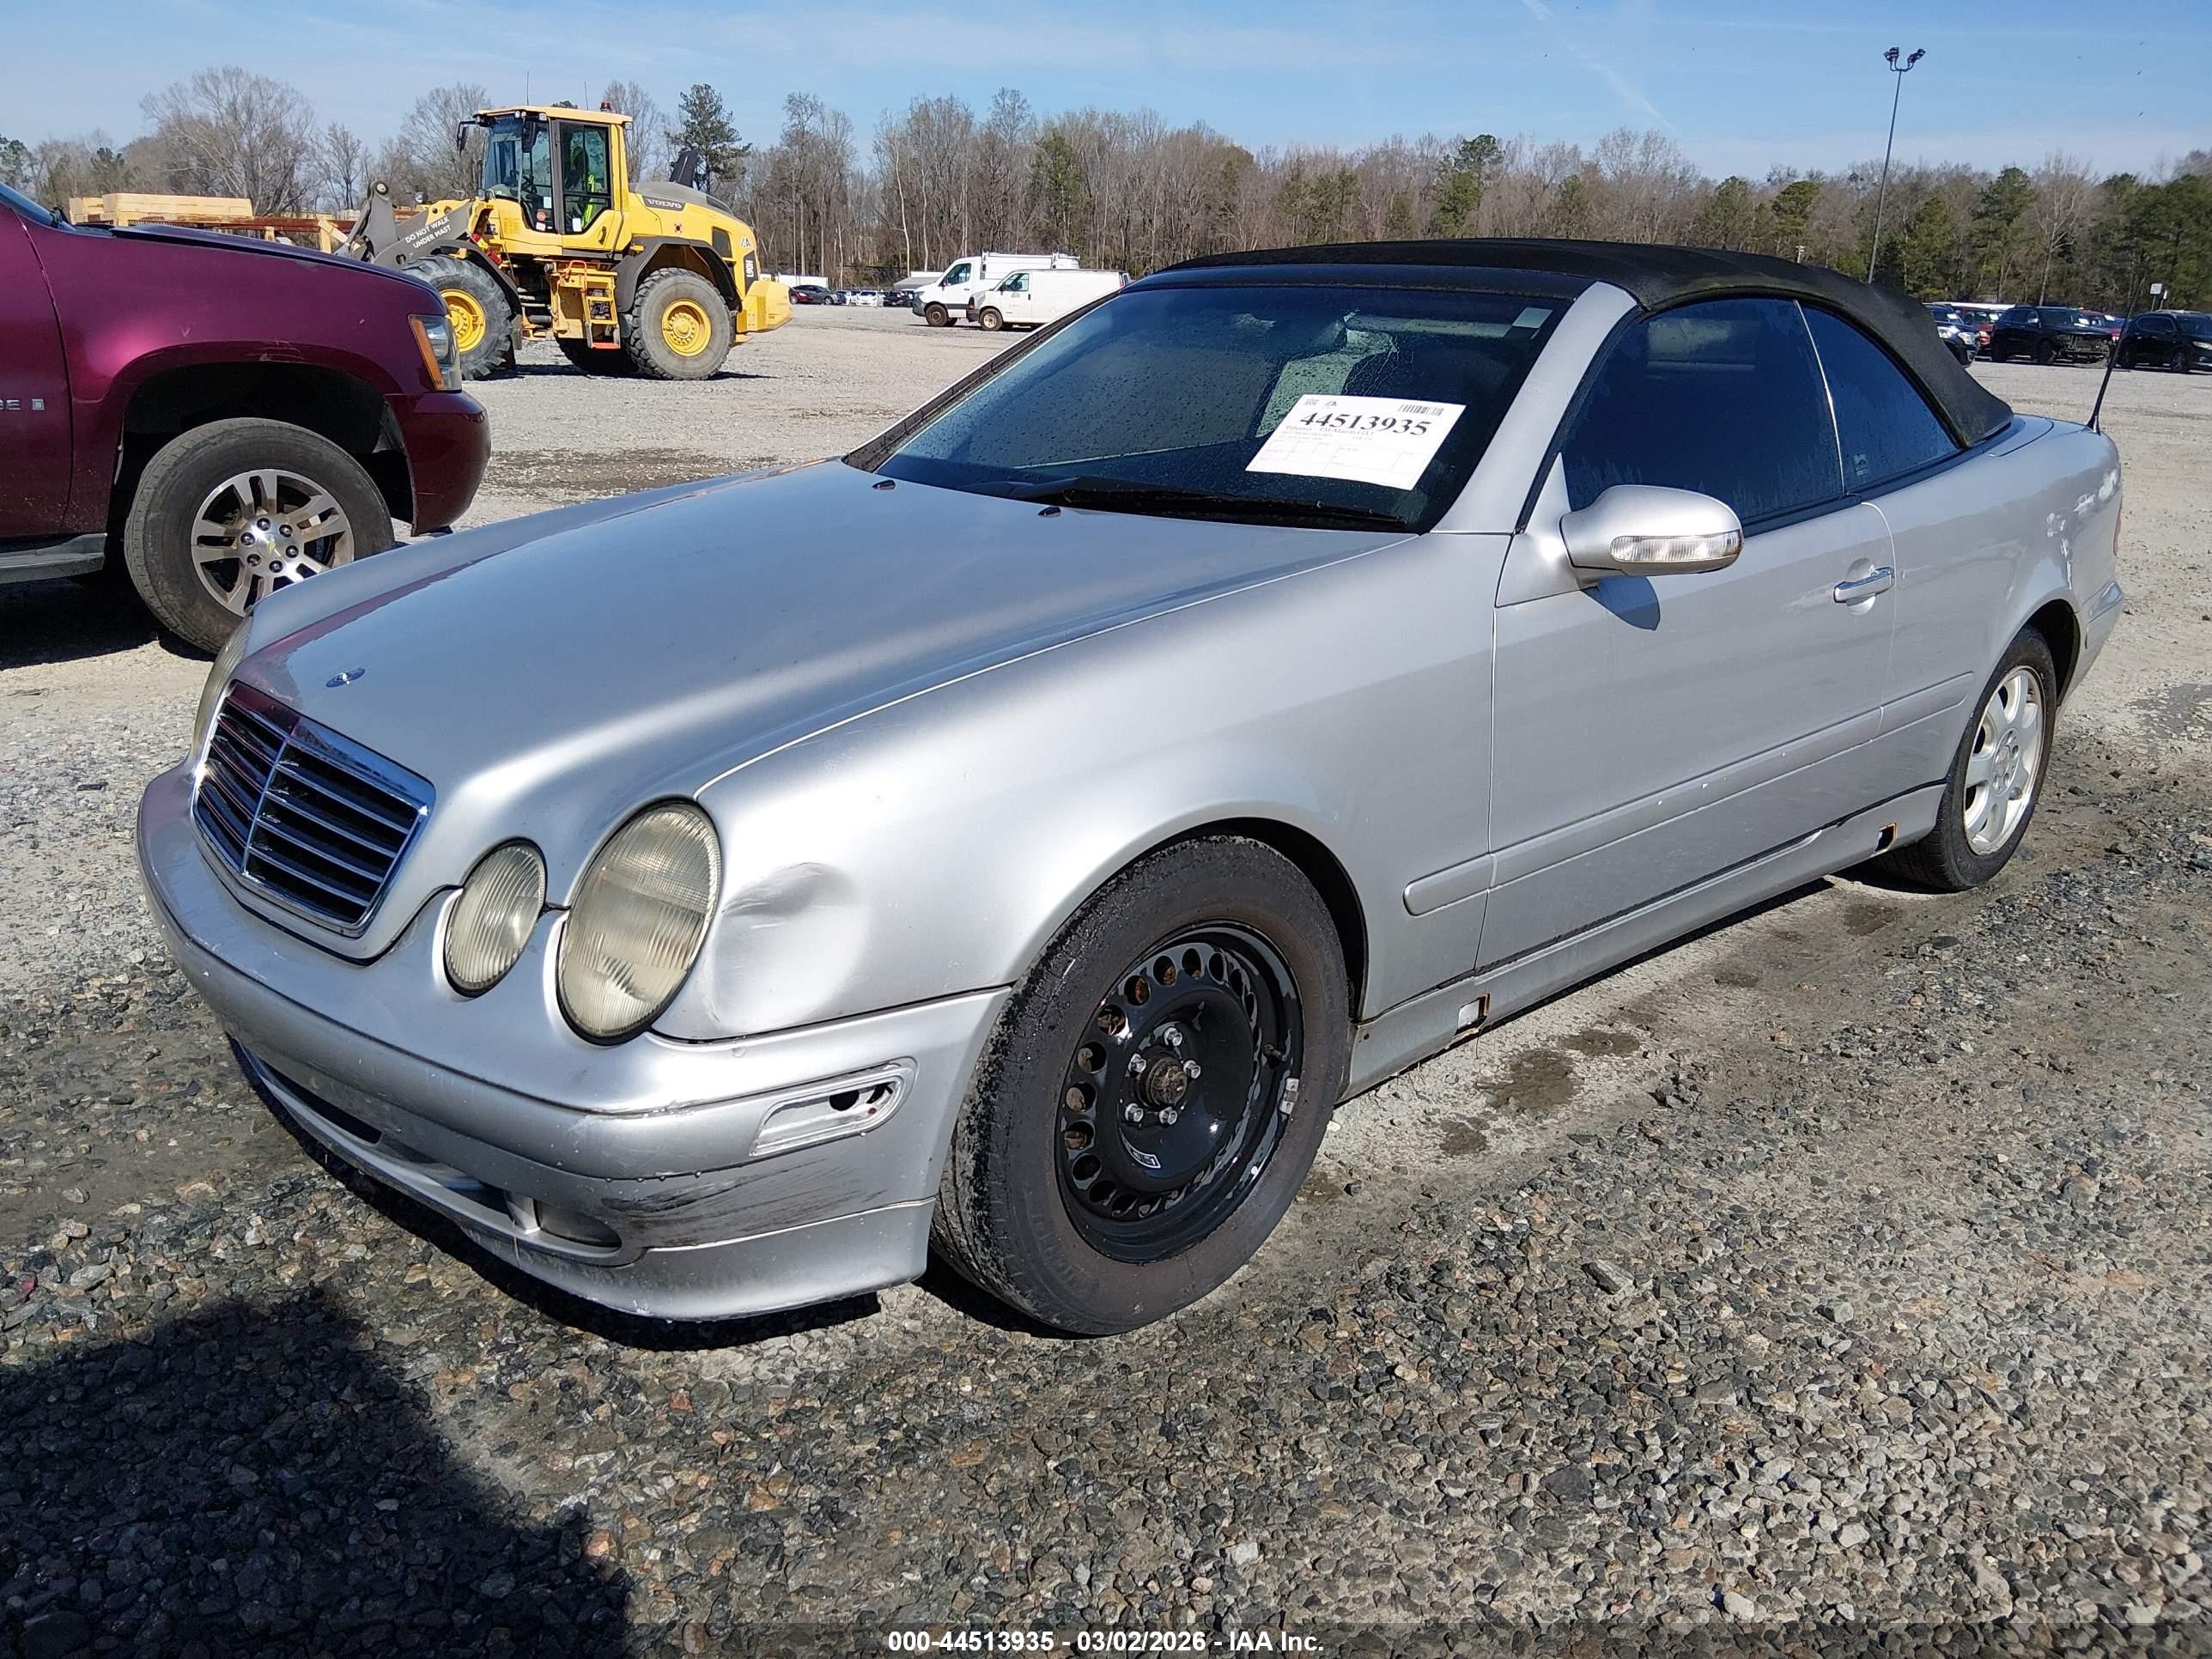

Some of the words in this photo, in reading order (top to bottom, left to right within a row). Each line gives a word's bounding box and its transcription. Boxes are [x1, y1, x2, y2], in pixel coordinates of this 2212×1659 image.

[645, 198, 683, 209] VOLVO
[405, 234, 416, 243] DO
[416, 226, 430, 238] NOT
[430, 216, 451, 229] WALK
[412, 234, 435, 248] UNDER
[434, 224, 452, 238] MAST
[1300, 412, 1432, 436] 44513935
